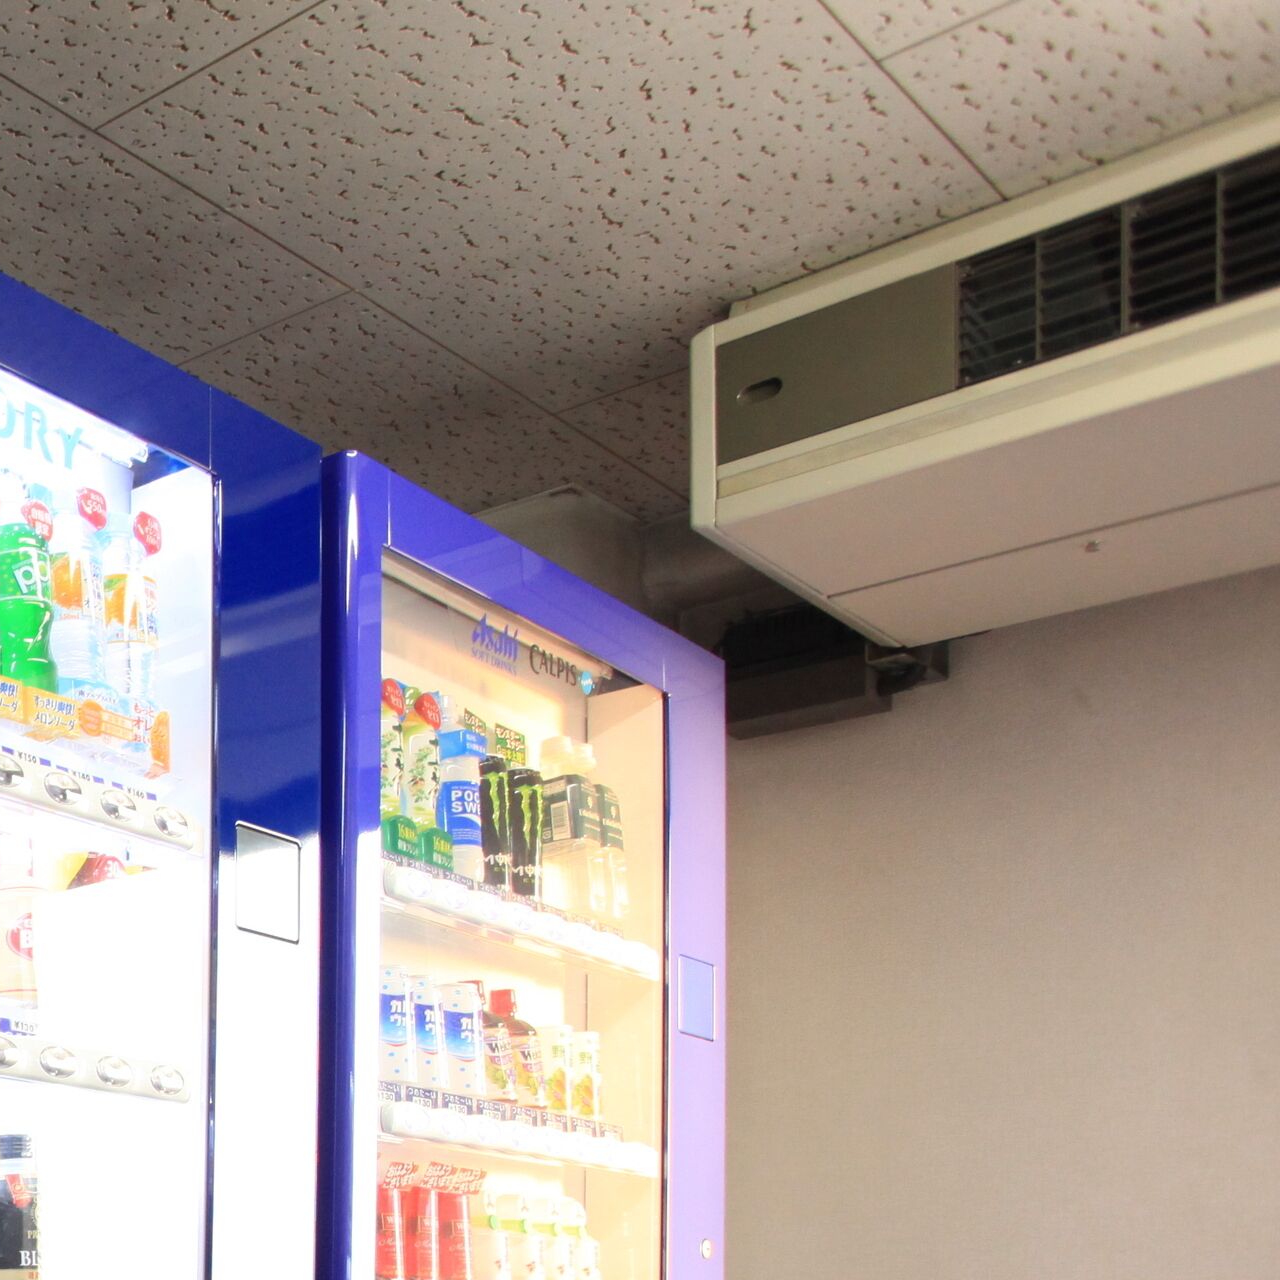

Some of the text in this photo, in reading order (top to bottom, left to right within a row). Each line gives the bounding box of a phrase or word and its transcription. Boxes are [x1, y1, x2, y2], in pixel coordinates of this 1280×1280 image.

[529, 644, 577, 686] CALPIS
[33, 710, 76, 730] メロンソーダ
[17, 751, 37, 765] ¥150
